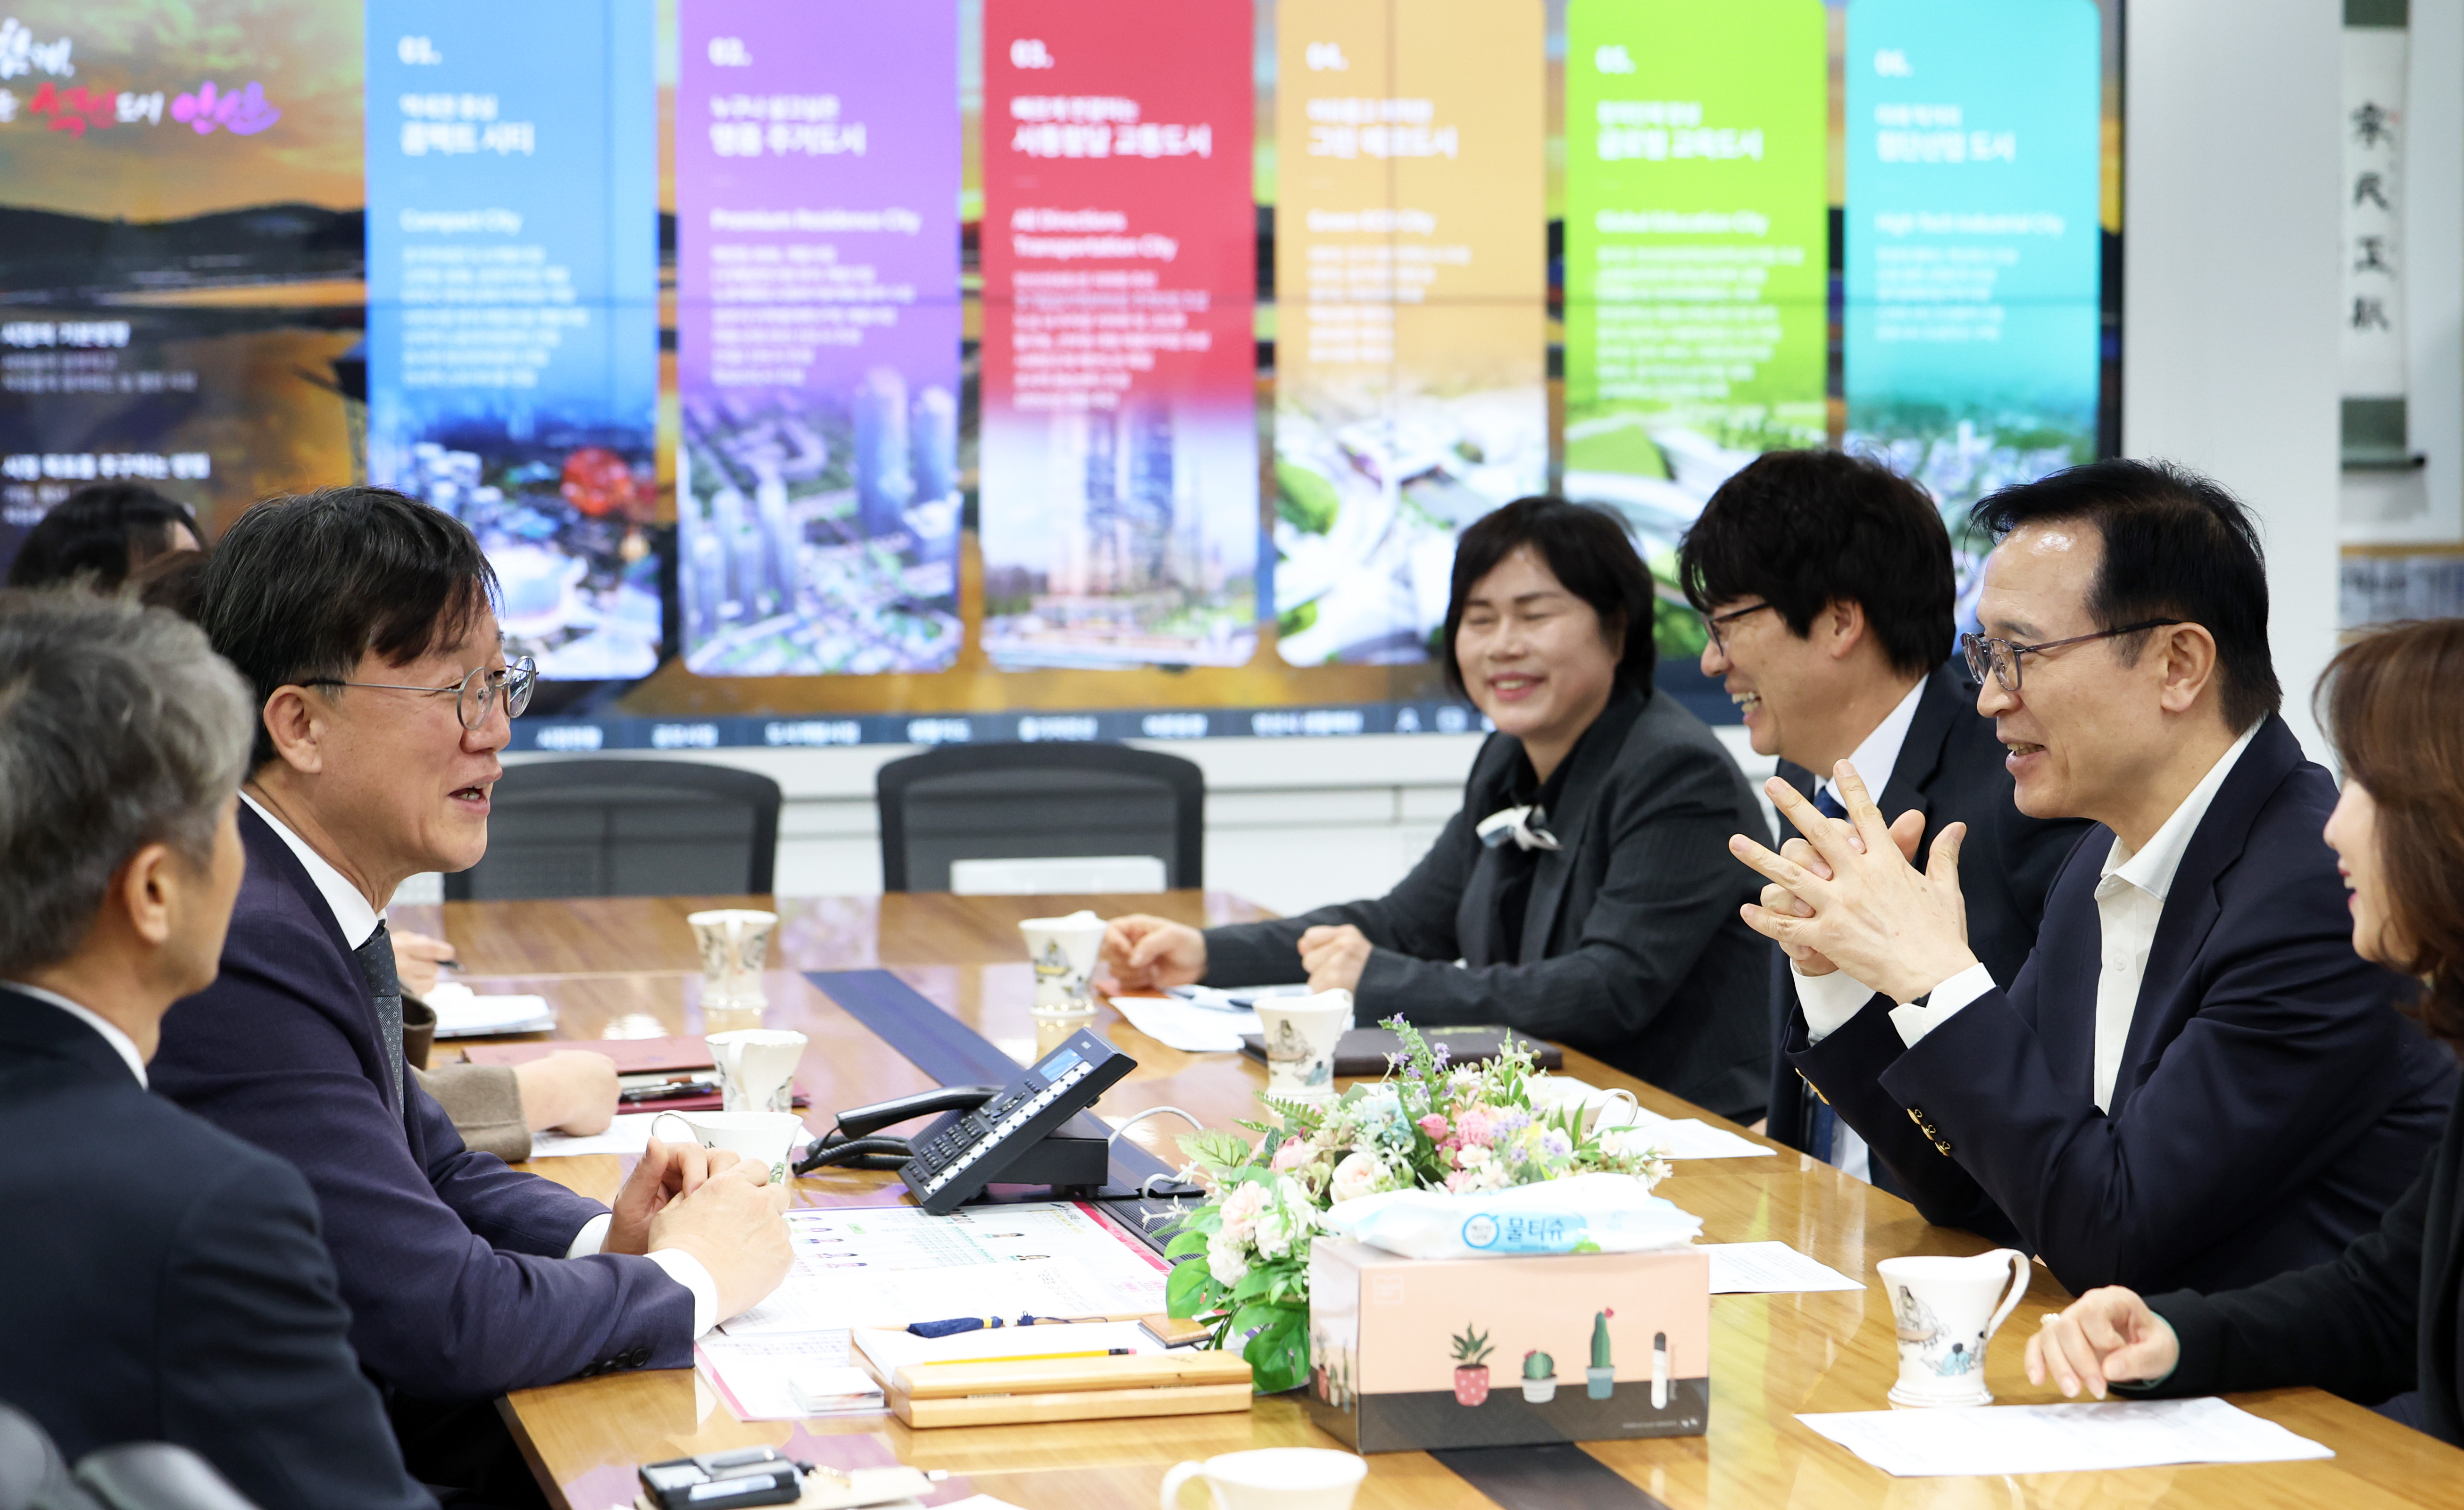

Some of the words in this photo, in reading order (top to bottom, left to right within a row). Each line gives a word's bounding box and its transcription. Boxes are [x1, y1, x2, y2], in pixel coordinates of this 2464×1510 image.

[171, 80, 281, 135] 안산
[480, 121, 535, 157] 시티
[1115, 123, 1213, 158] 교통도시
[882, 207, 924, 236] City
[1138, 233, 1178, 262] City
[1506, 1215, 1565, 1242] 물티슈
